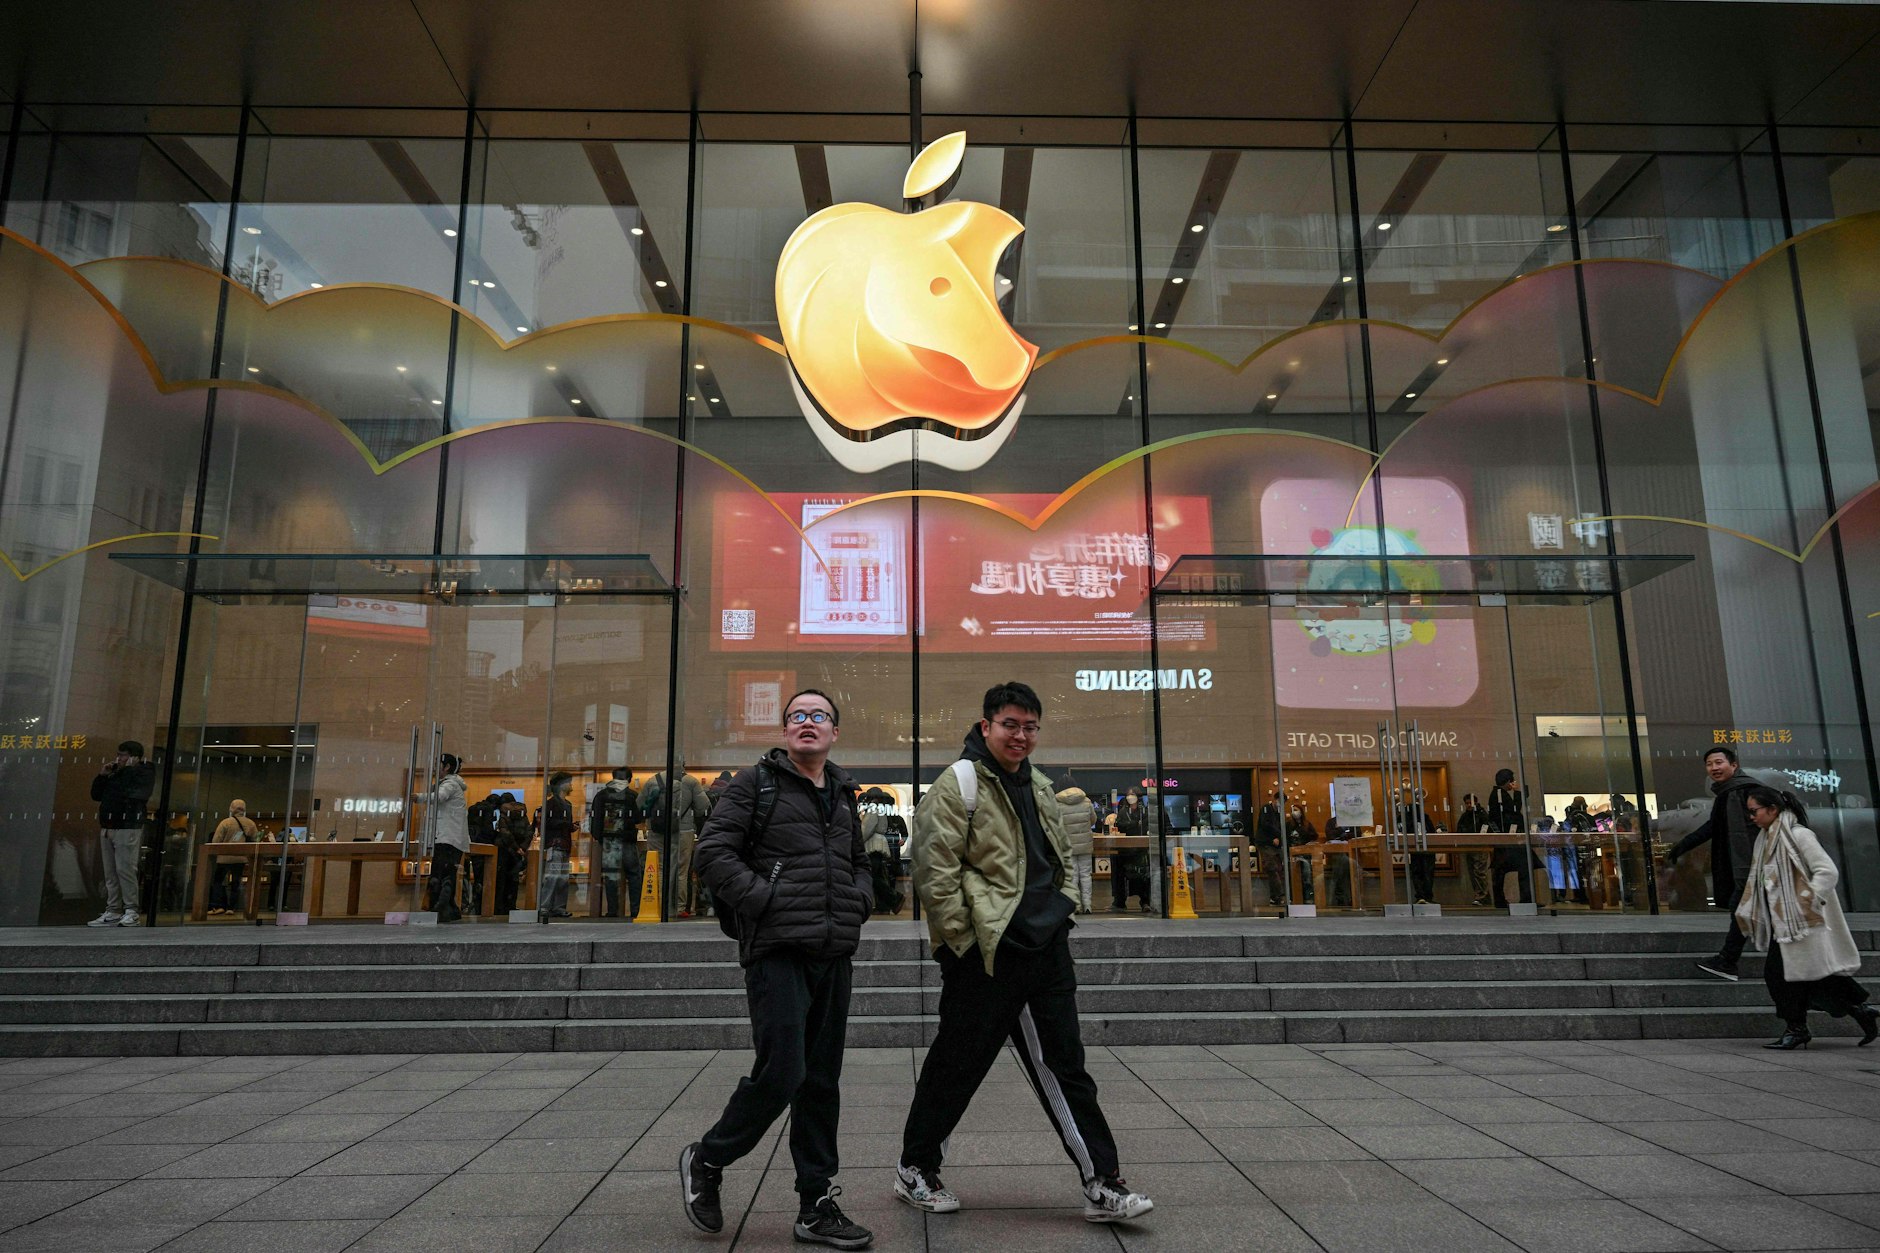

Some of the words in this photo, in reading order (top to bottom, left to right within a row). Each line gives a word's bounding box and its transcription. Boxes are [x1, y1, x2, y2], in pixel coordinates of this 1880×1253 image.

[0, 734, 87, 750] 跃来跃出彩
[1713, 729, 1793, 744] 跃来跃出彩
[1149, 778, 1178, 787] Msic
